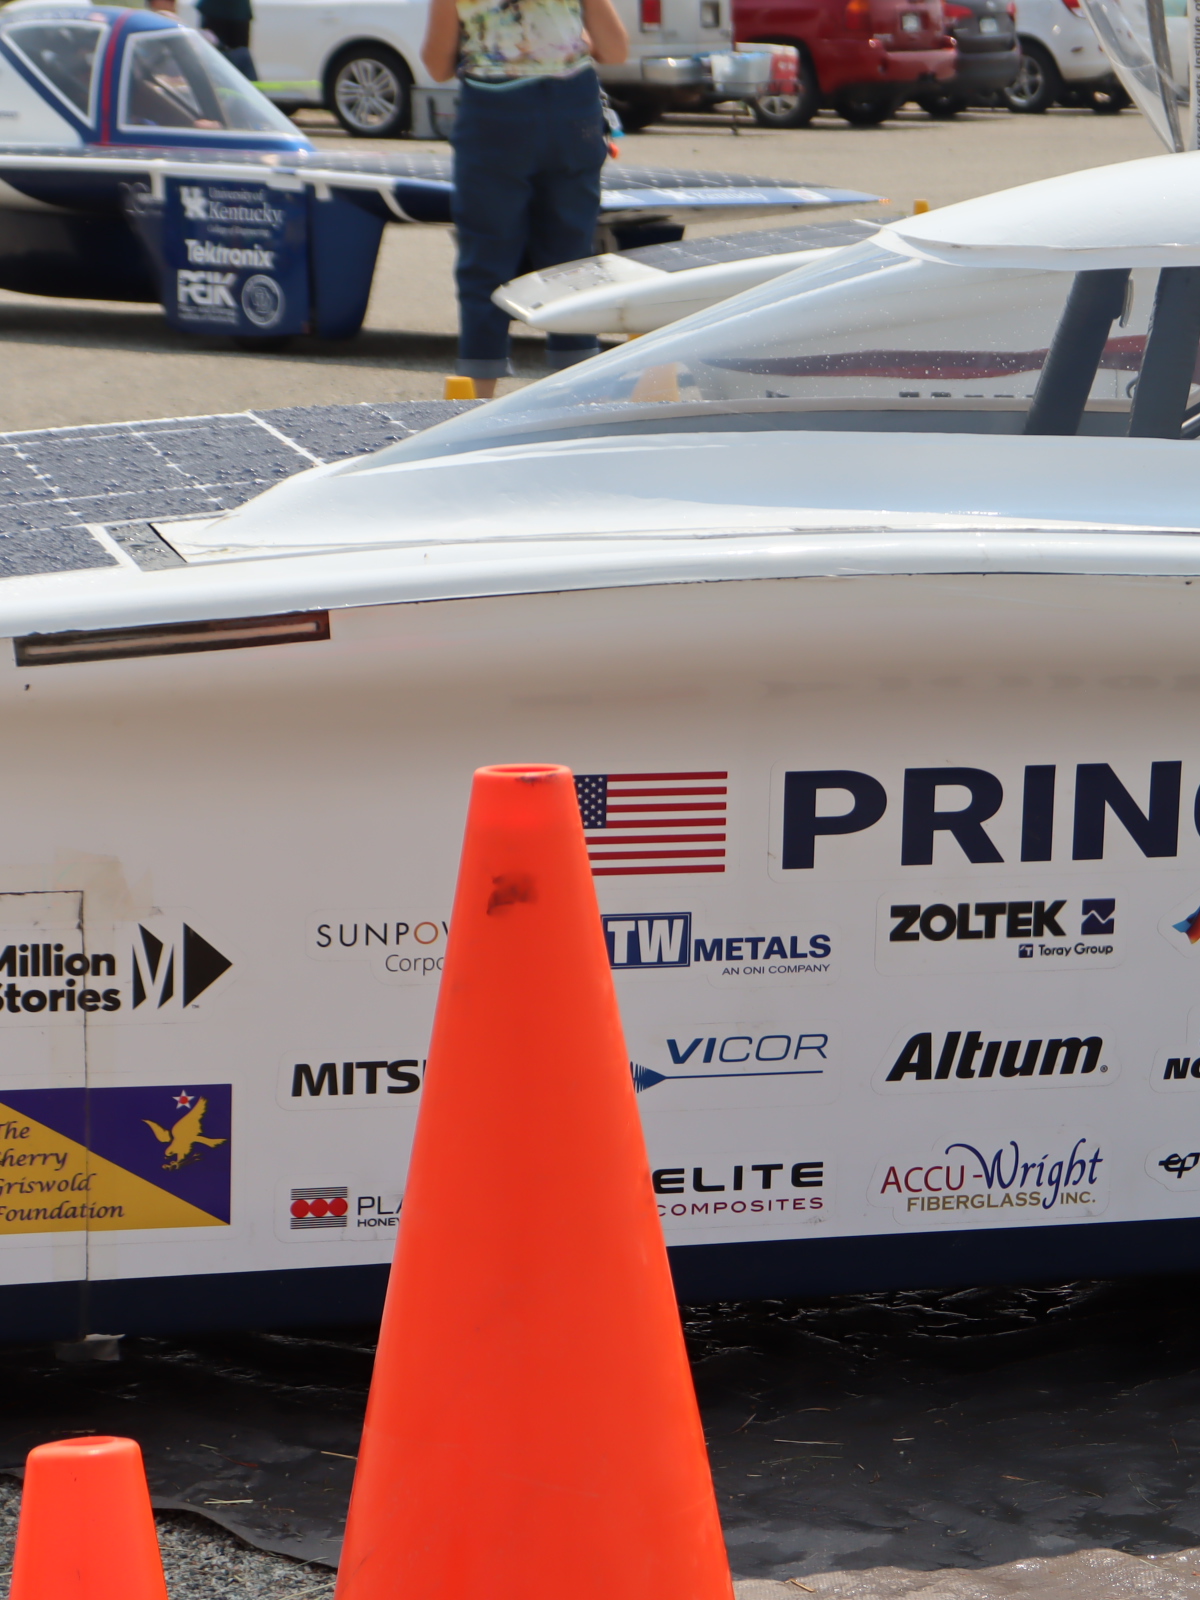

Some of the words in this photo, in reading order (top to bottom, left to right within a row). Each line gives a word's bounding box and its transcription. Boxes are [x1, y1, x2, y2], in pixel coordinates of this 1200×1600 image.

[208, 186, 252, 203] University
[208, 201, 284, 229] Kentucky
[184, 238, 275, 270] Tektronix
[889, 900, 1068, 942] ZOLTEK
[607, 918, 685, 964] TW
[694, 934, 832, 962] METALS
[1038, 943, 1071, 957] Toray
[1073, 942, 1114, 956] Group
[721, 967, 740, 976] AN
[743, 966, 765, 975] ONI
[768, 964, 831, 974] COMPANY
[0, 978, 121, 1013] tories
[666, 1033, 829, 1064] VICOR
[291, 1059, 427, 1097] MITS
[0, 1147, 68, 1171] herry
[652, 1161, 824, 1195] ELITE
[657, 1197, 824, 1217] COMPOSITES
[906, 1191, 1042, 1212] FIBERGLASS
[1059, 1191, 1097, 1205] INC.
